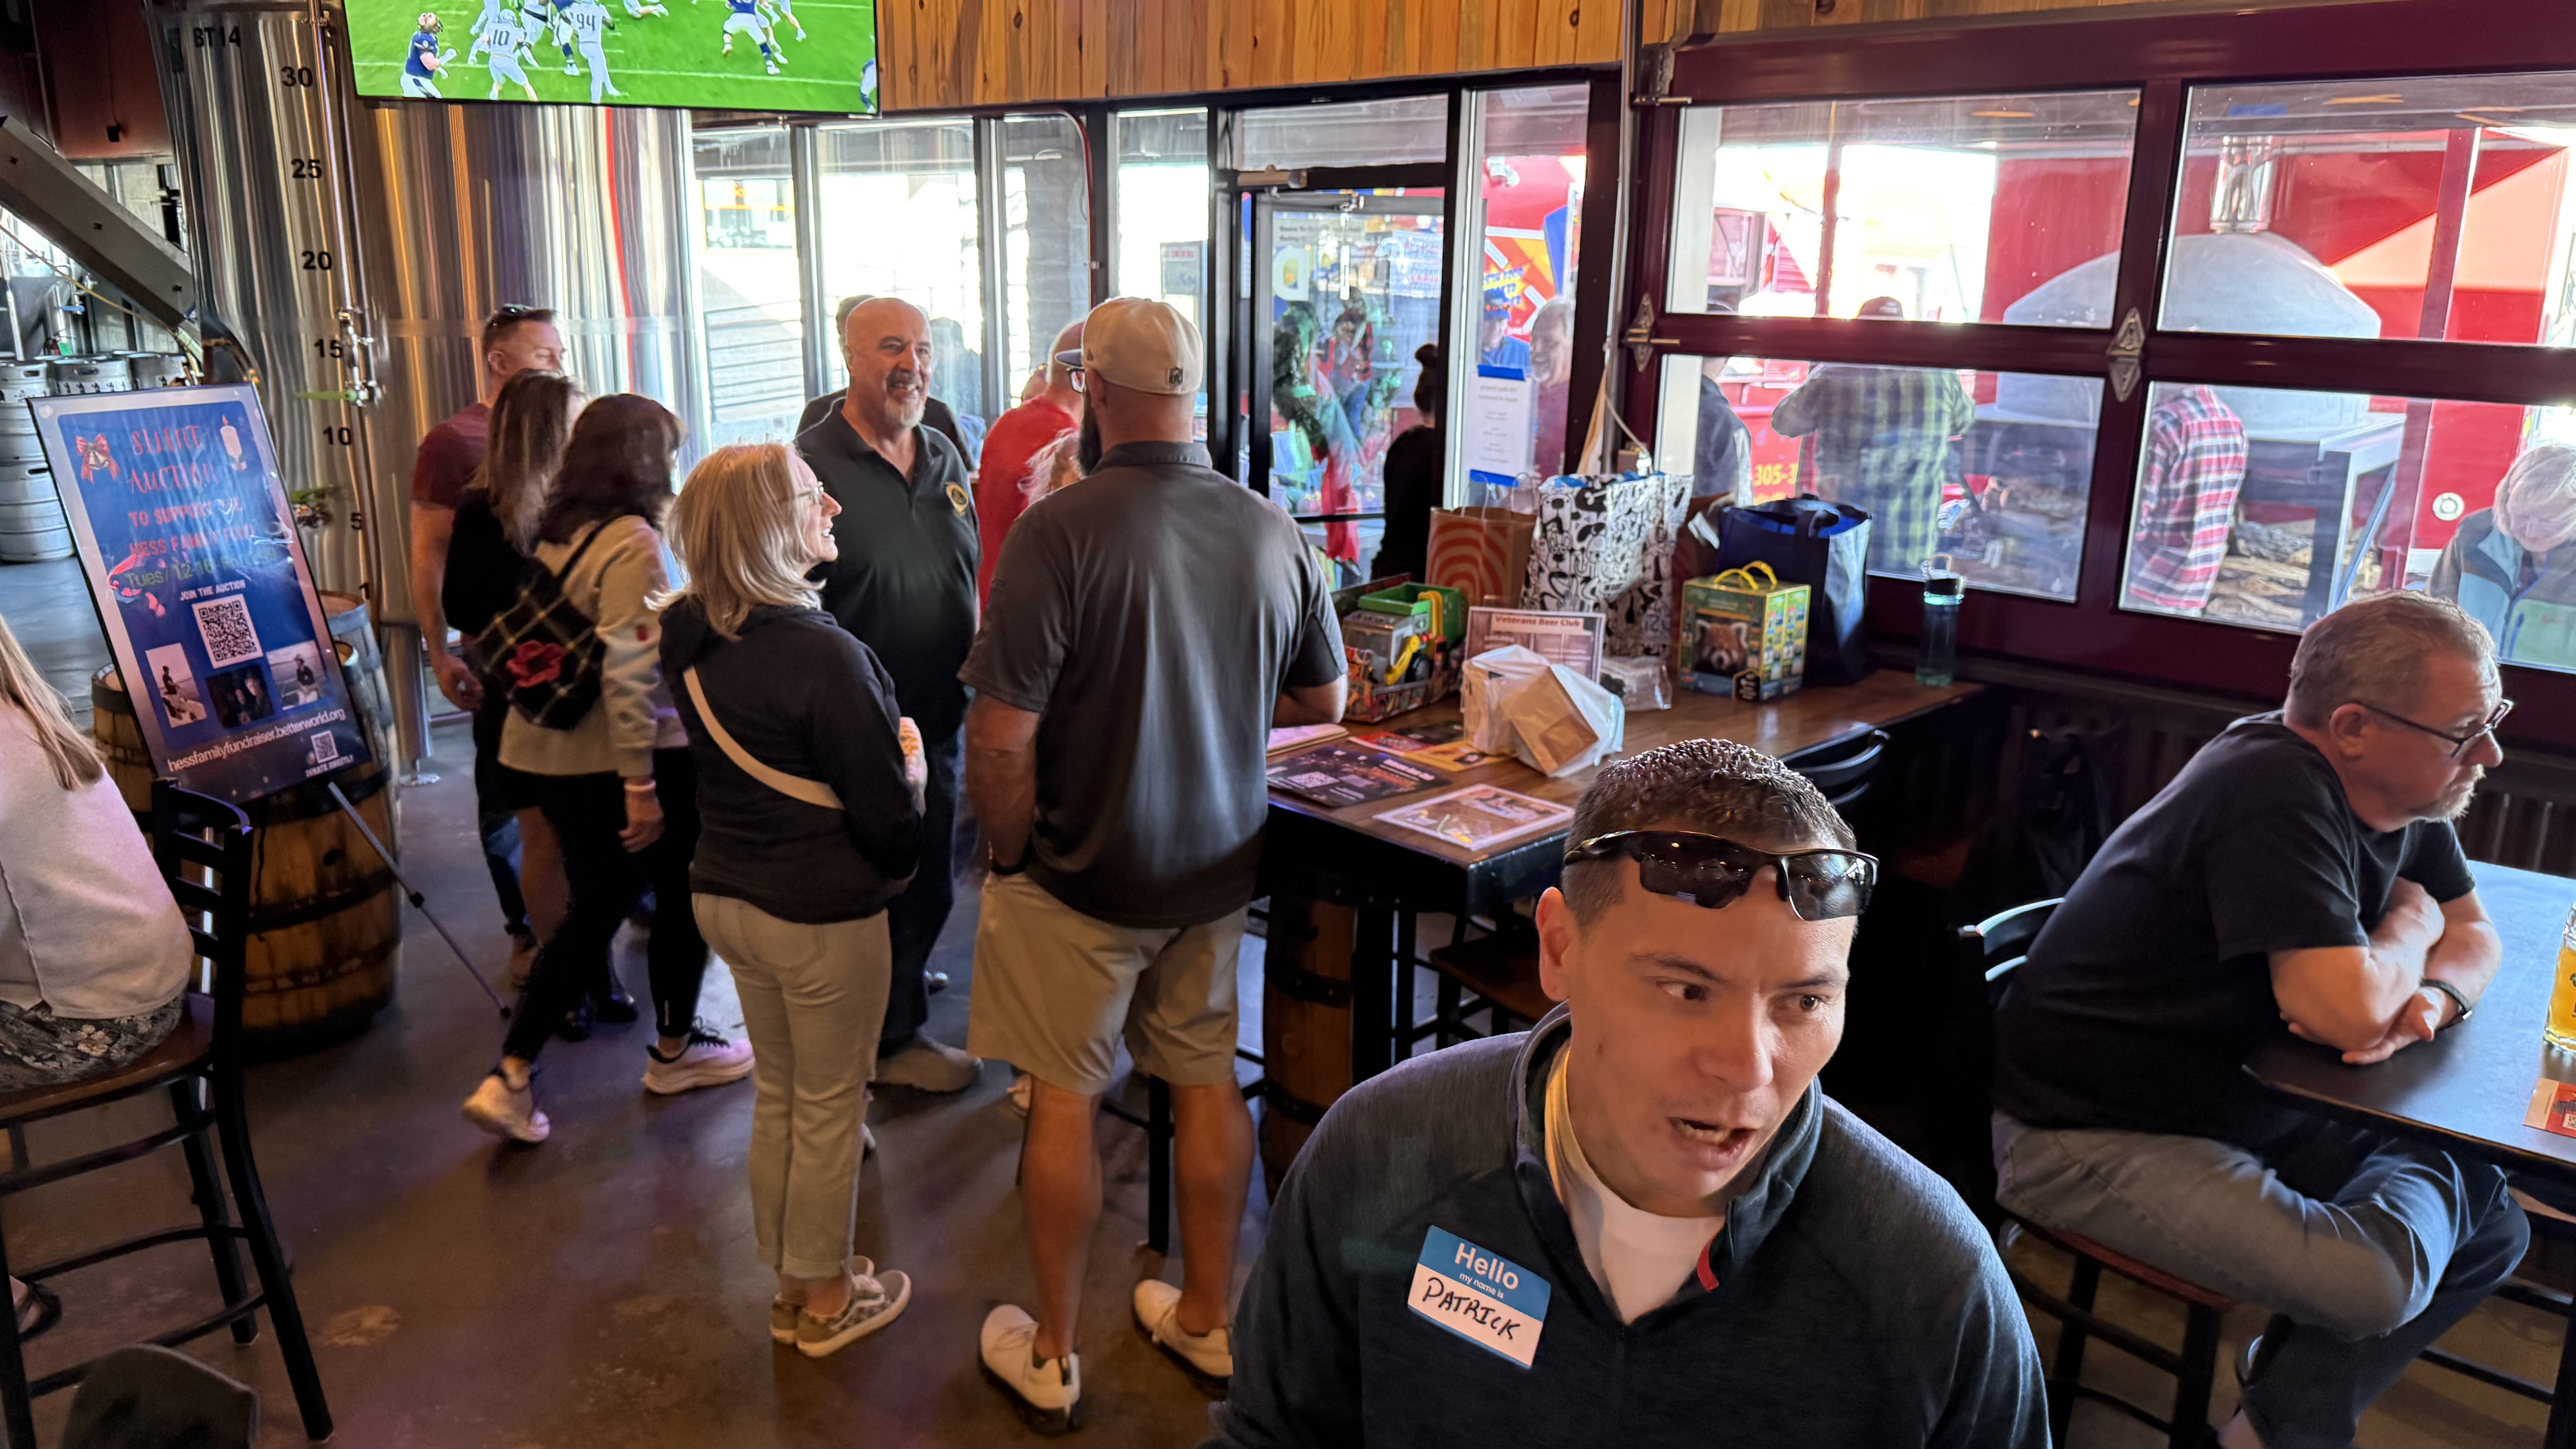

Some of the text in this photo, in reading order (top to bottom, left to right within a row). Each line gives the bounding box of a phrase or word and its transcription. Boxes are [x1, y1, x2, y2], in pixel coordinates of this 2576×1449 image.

[576, 13, 596, 32] 94
[218, 25, 241, 47] 14
[492, 28, 510, 46] 10
[281, 66, 313, 87] 30
[291, 158, 322, 179] 25
[301, 250, 332, 270] 20
[314, 338, 343, 359] 15
[323, 426, 352, 446] 10
[127, 462, 220, 494] AUCTION
[128, 511, 150, 528] TO
[154, 501, 214, 525] SUPPORT
[351, 512, 362, 531] 5
[129, 538, 167, 557] HESS
[179, 579, 247, 601] JOIN THE AUCTION
[1495, 615, 1536, 626] Veterans
[167, 707, 346, 773] hessfamilyfundraiser.betterworld.org
[1455, 1242, 1519, 1290] Hello
[1459, 1272, 1504, 1300] my name is
[1422, 1277, 1521, 1341] PATRICK
